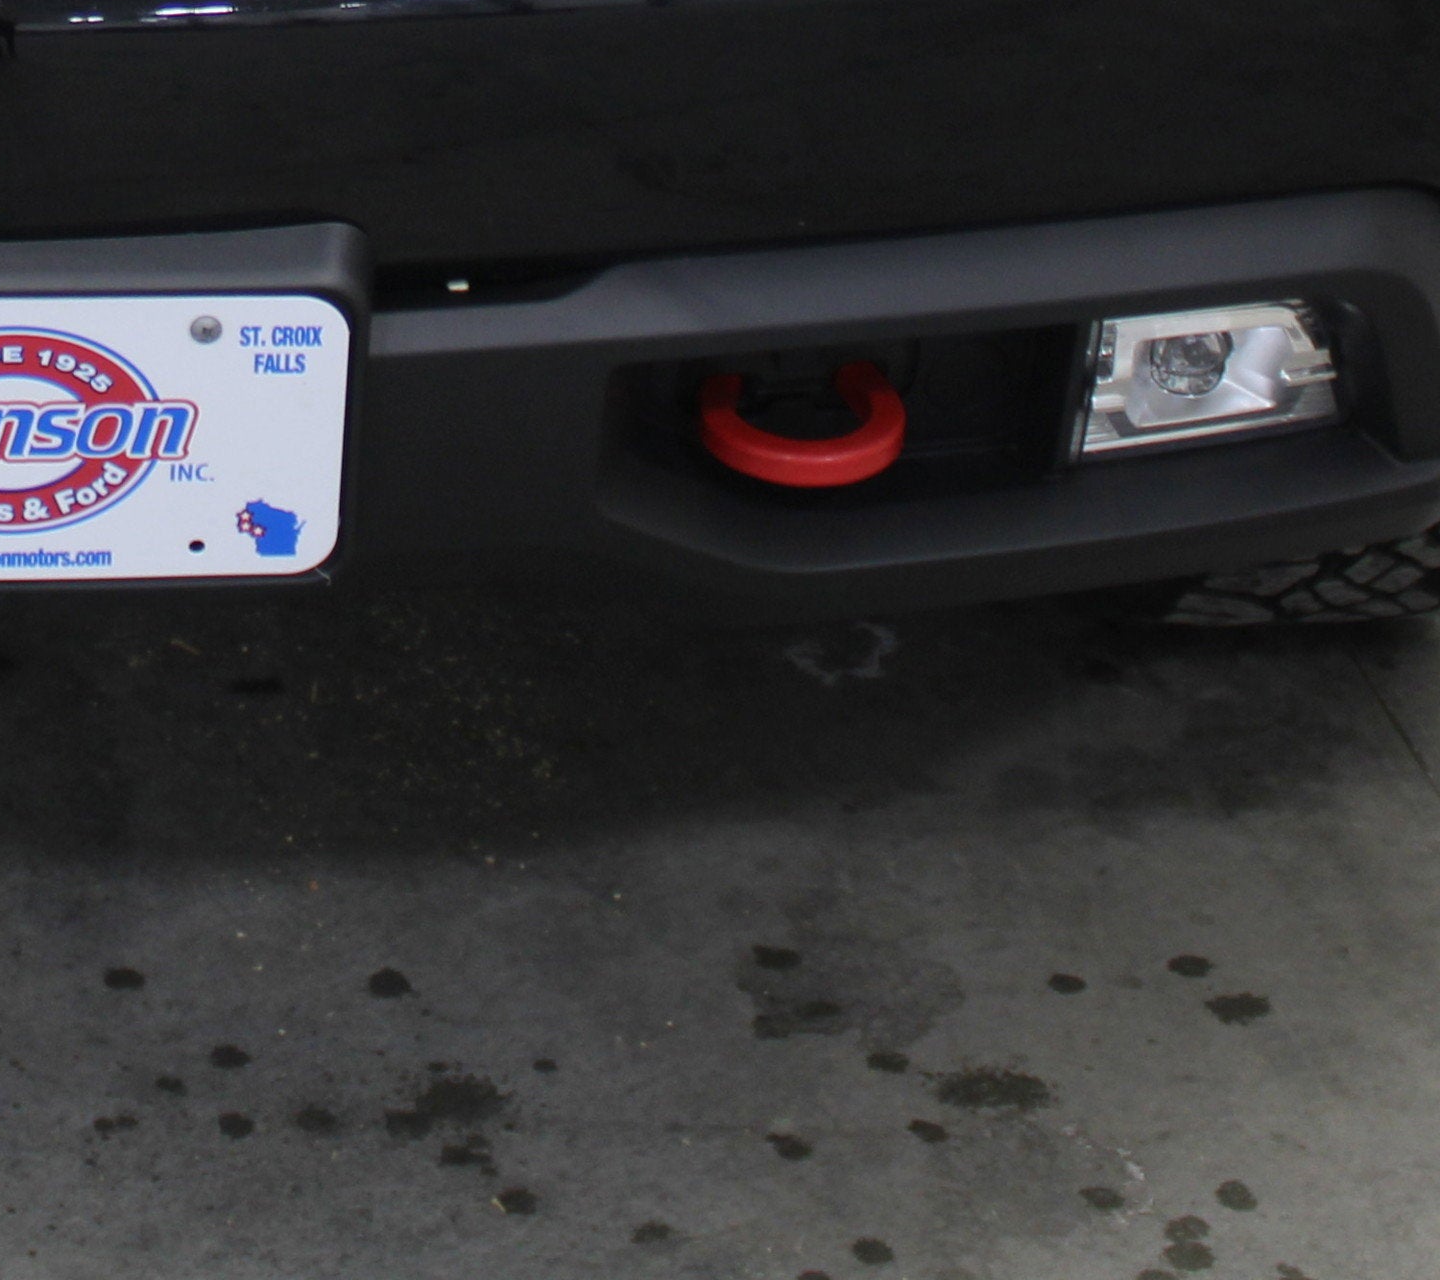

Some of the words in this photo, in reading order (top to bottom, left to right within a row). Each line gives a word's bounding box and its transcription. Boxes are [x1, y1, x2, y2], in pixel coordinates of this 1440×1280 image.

[239, 325, 266, 347] ST.
[271, 325, 323, 347] CROIX
[38, 348, 114, 394] 1925
[253, 352, 306, 375] FALLS
[169, 464, 215, 483] INC.
[22, 496, 49, 522] &
[54, 461, 129, 515] Ford
